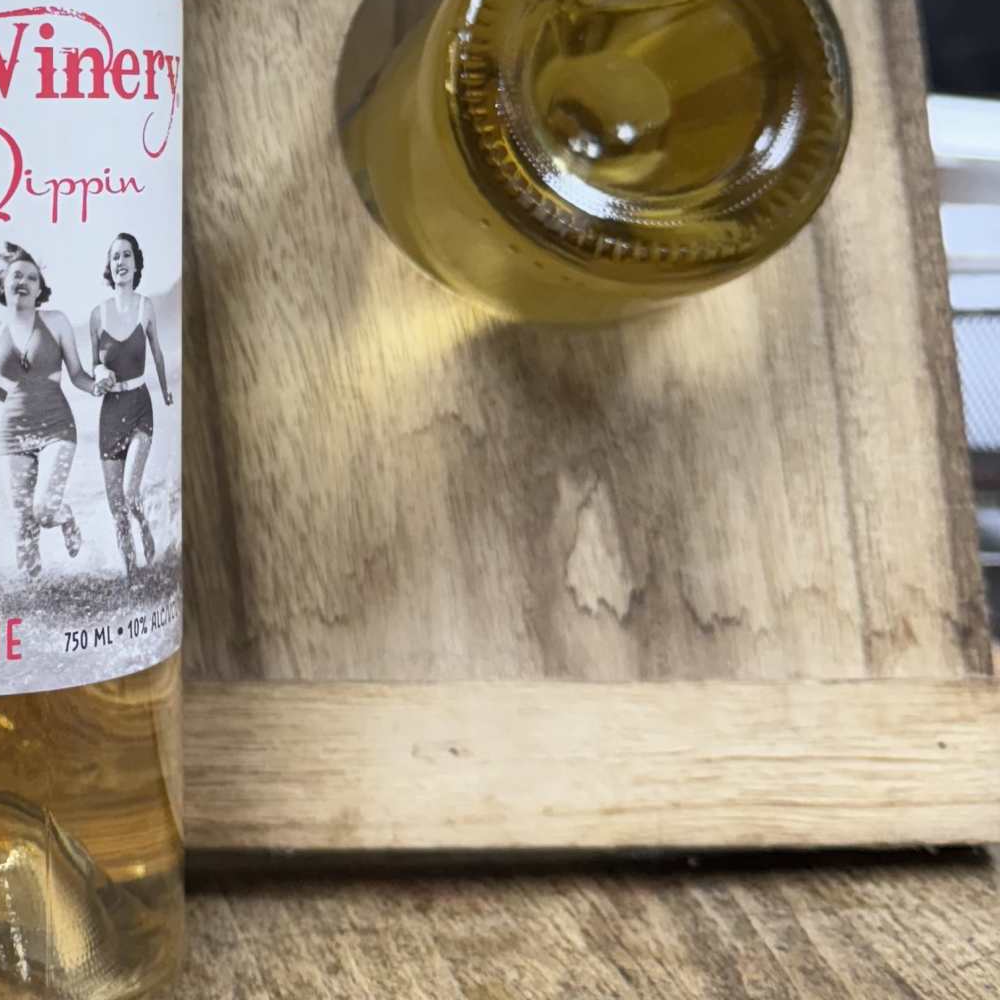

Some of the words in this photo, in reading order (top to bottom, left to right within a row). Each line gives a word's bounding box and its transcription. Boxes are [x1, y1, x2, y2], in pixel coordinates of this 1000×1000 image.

[64, 629, 88, 652] 750
[94, 625, 113, 647] ML
[127, 616, 147, 639] 10%
